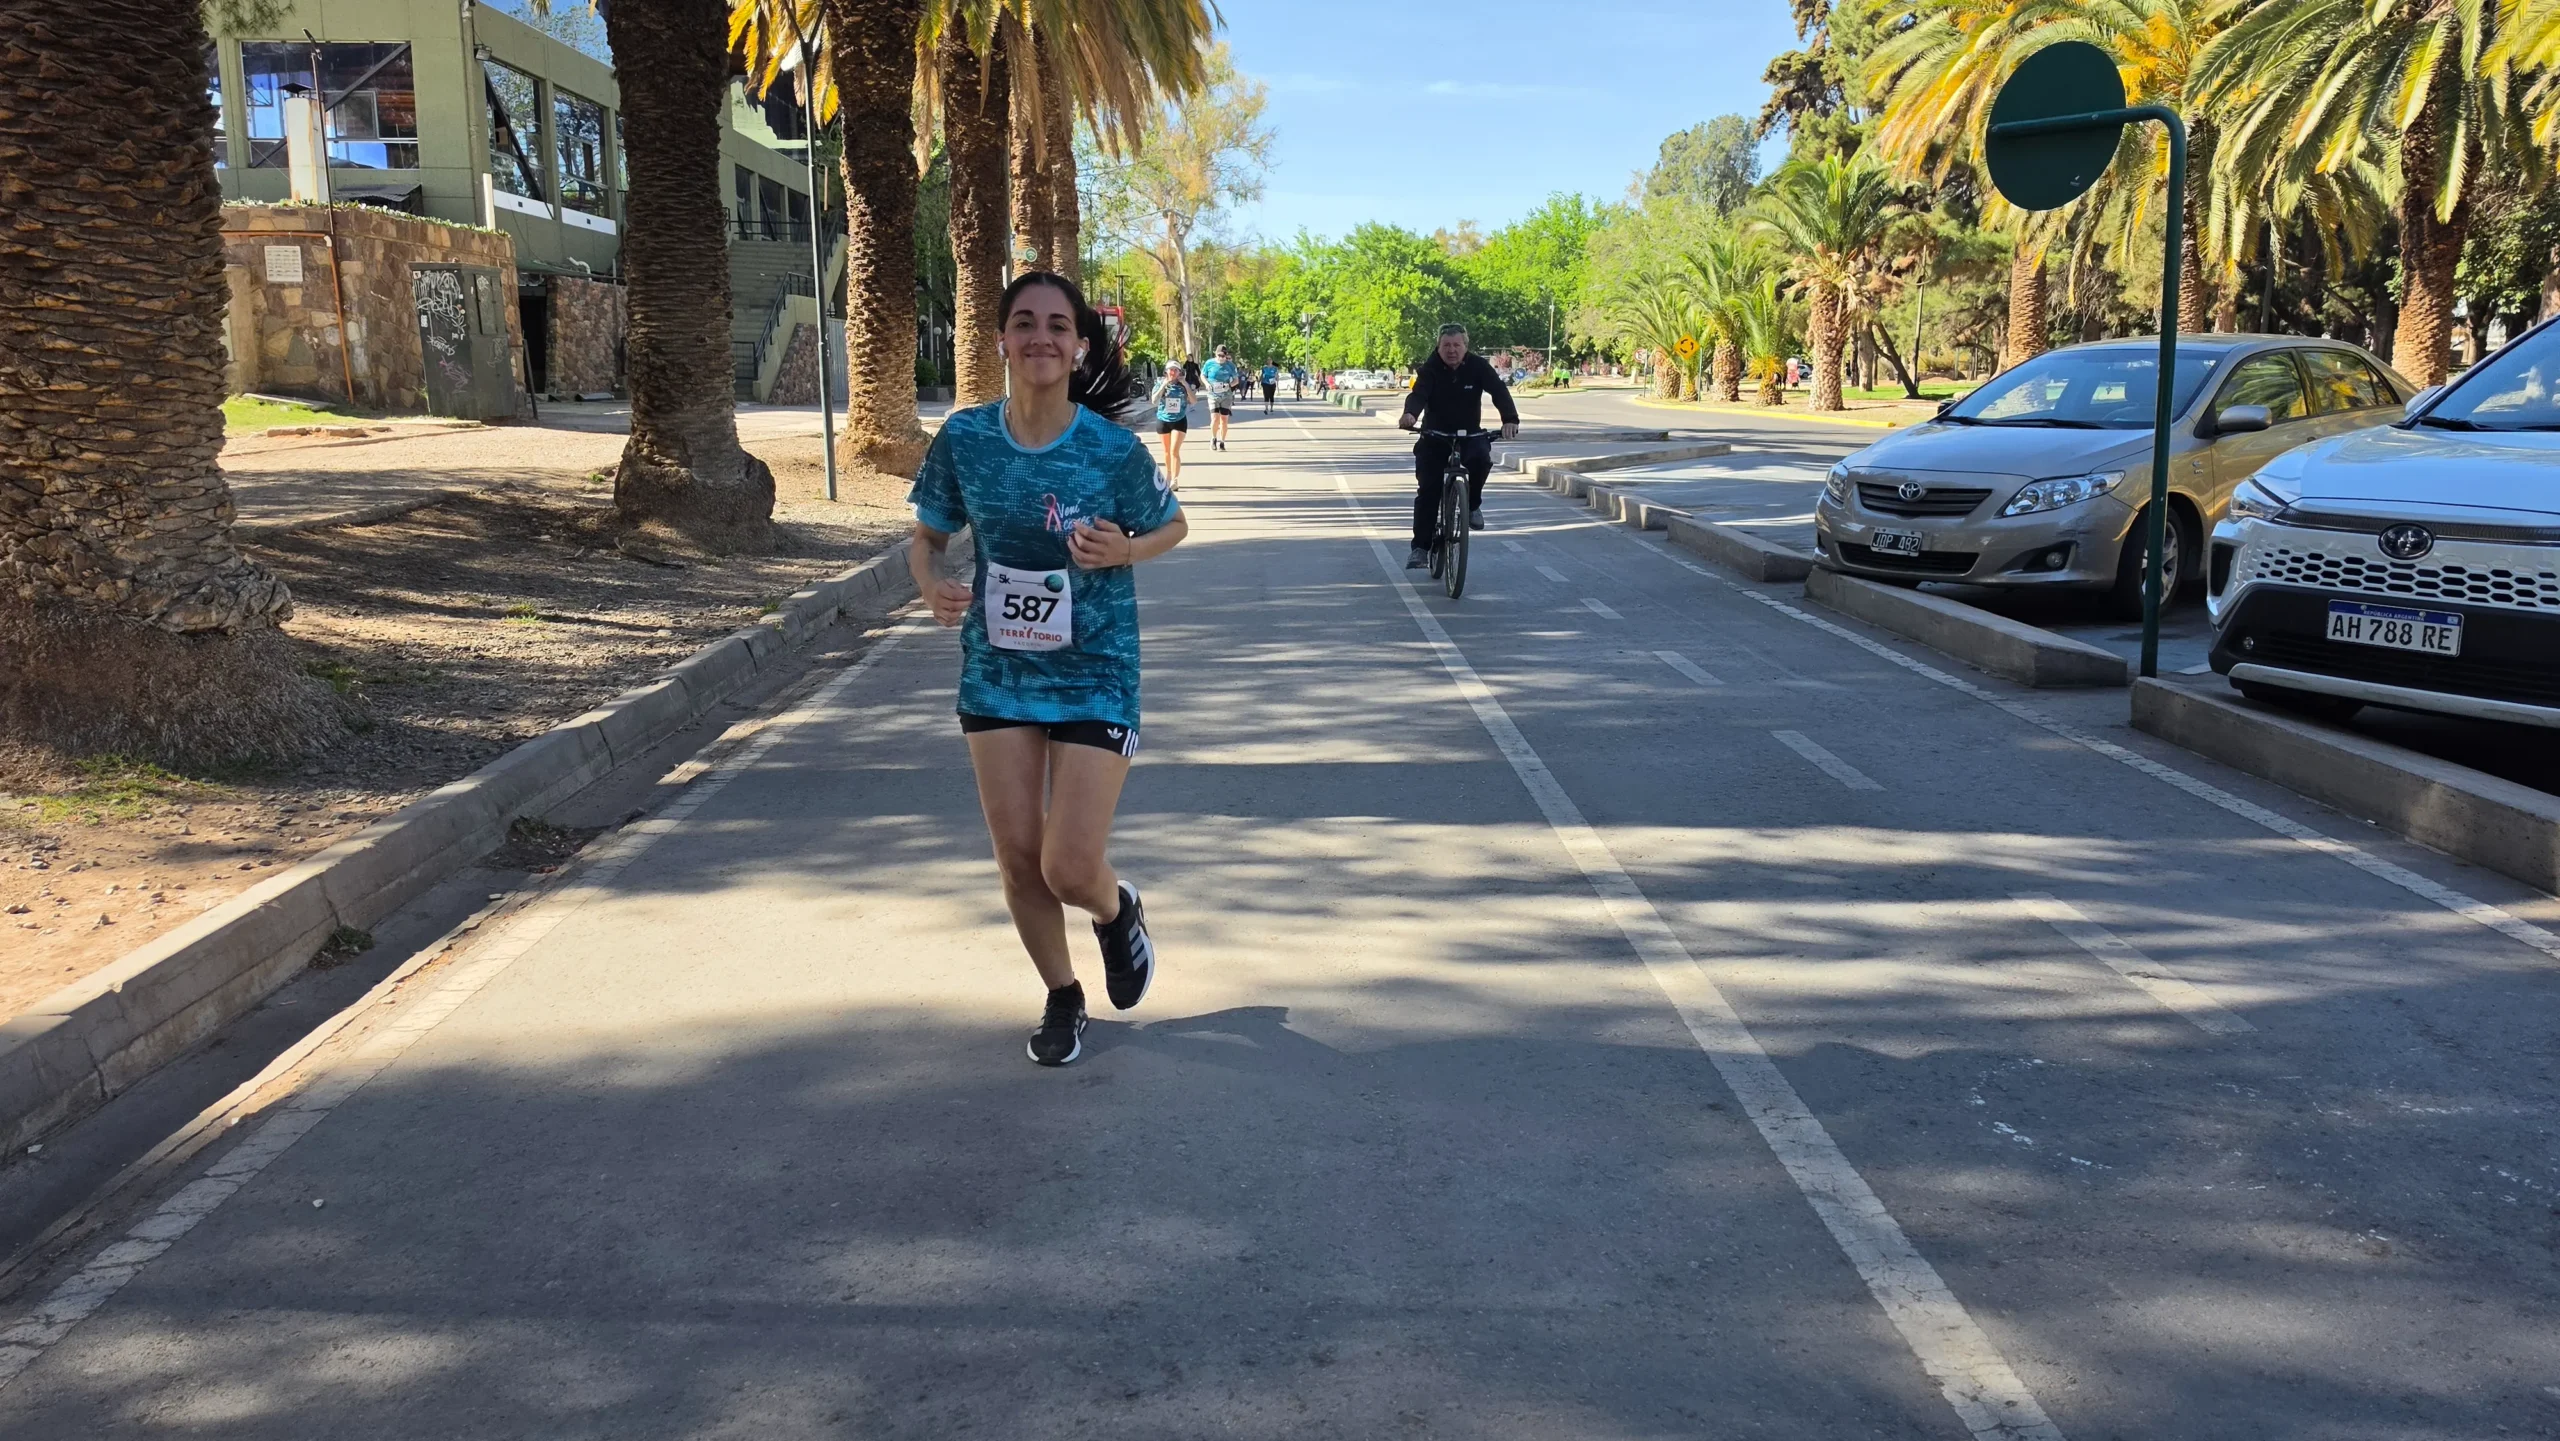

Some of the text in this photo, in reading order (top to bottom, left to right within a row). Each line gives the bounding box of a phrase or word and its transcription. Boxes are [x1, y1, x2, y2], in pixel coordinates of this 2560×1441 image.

[1002, 593, 1059, 623] 587
[2331, 614, 2453, 651] AH 788 RE
